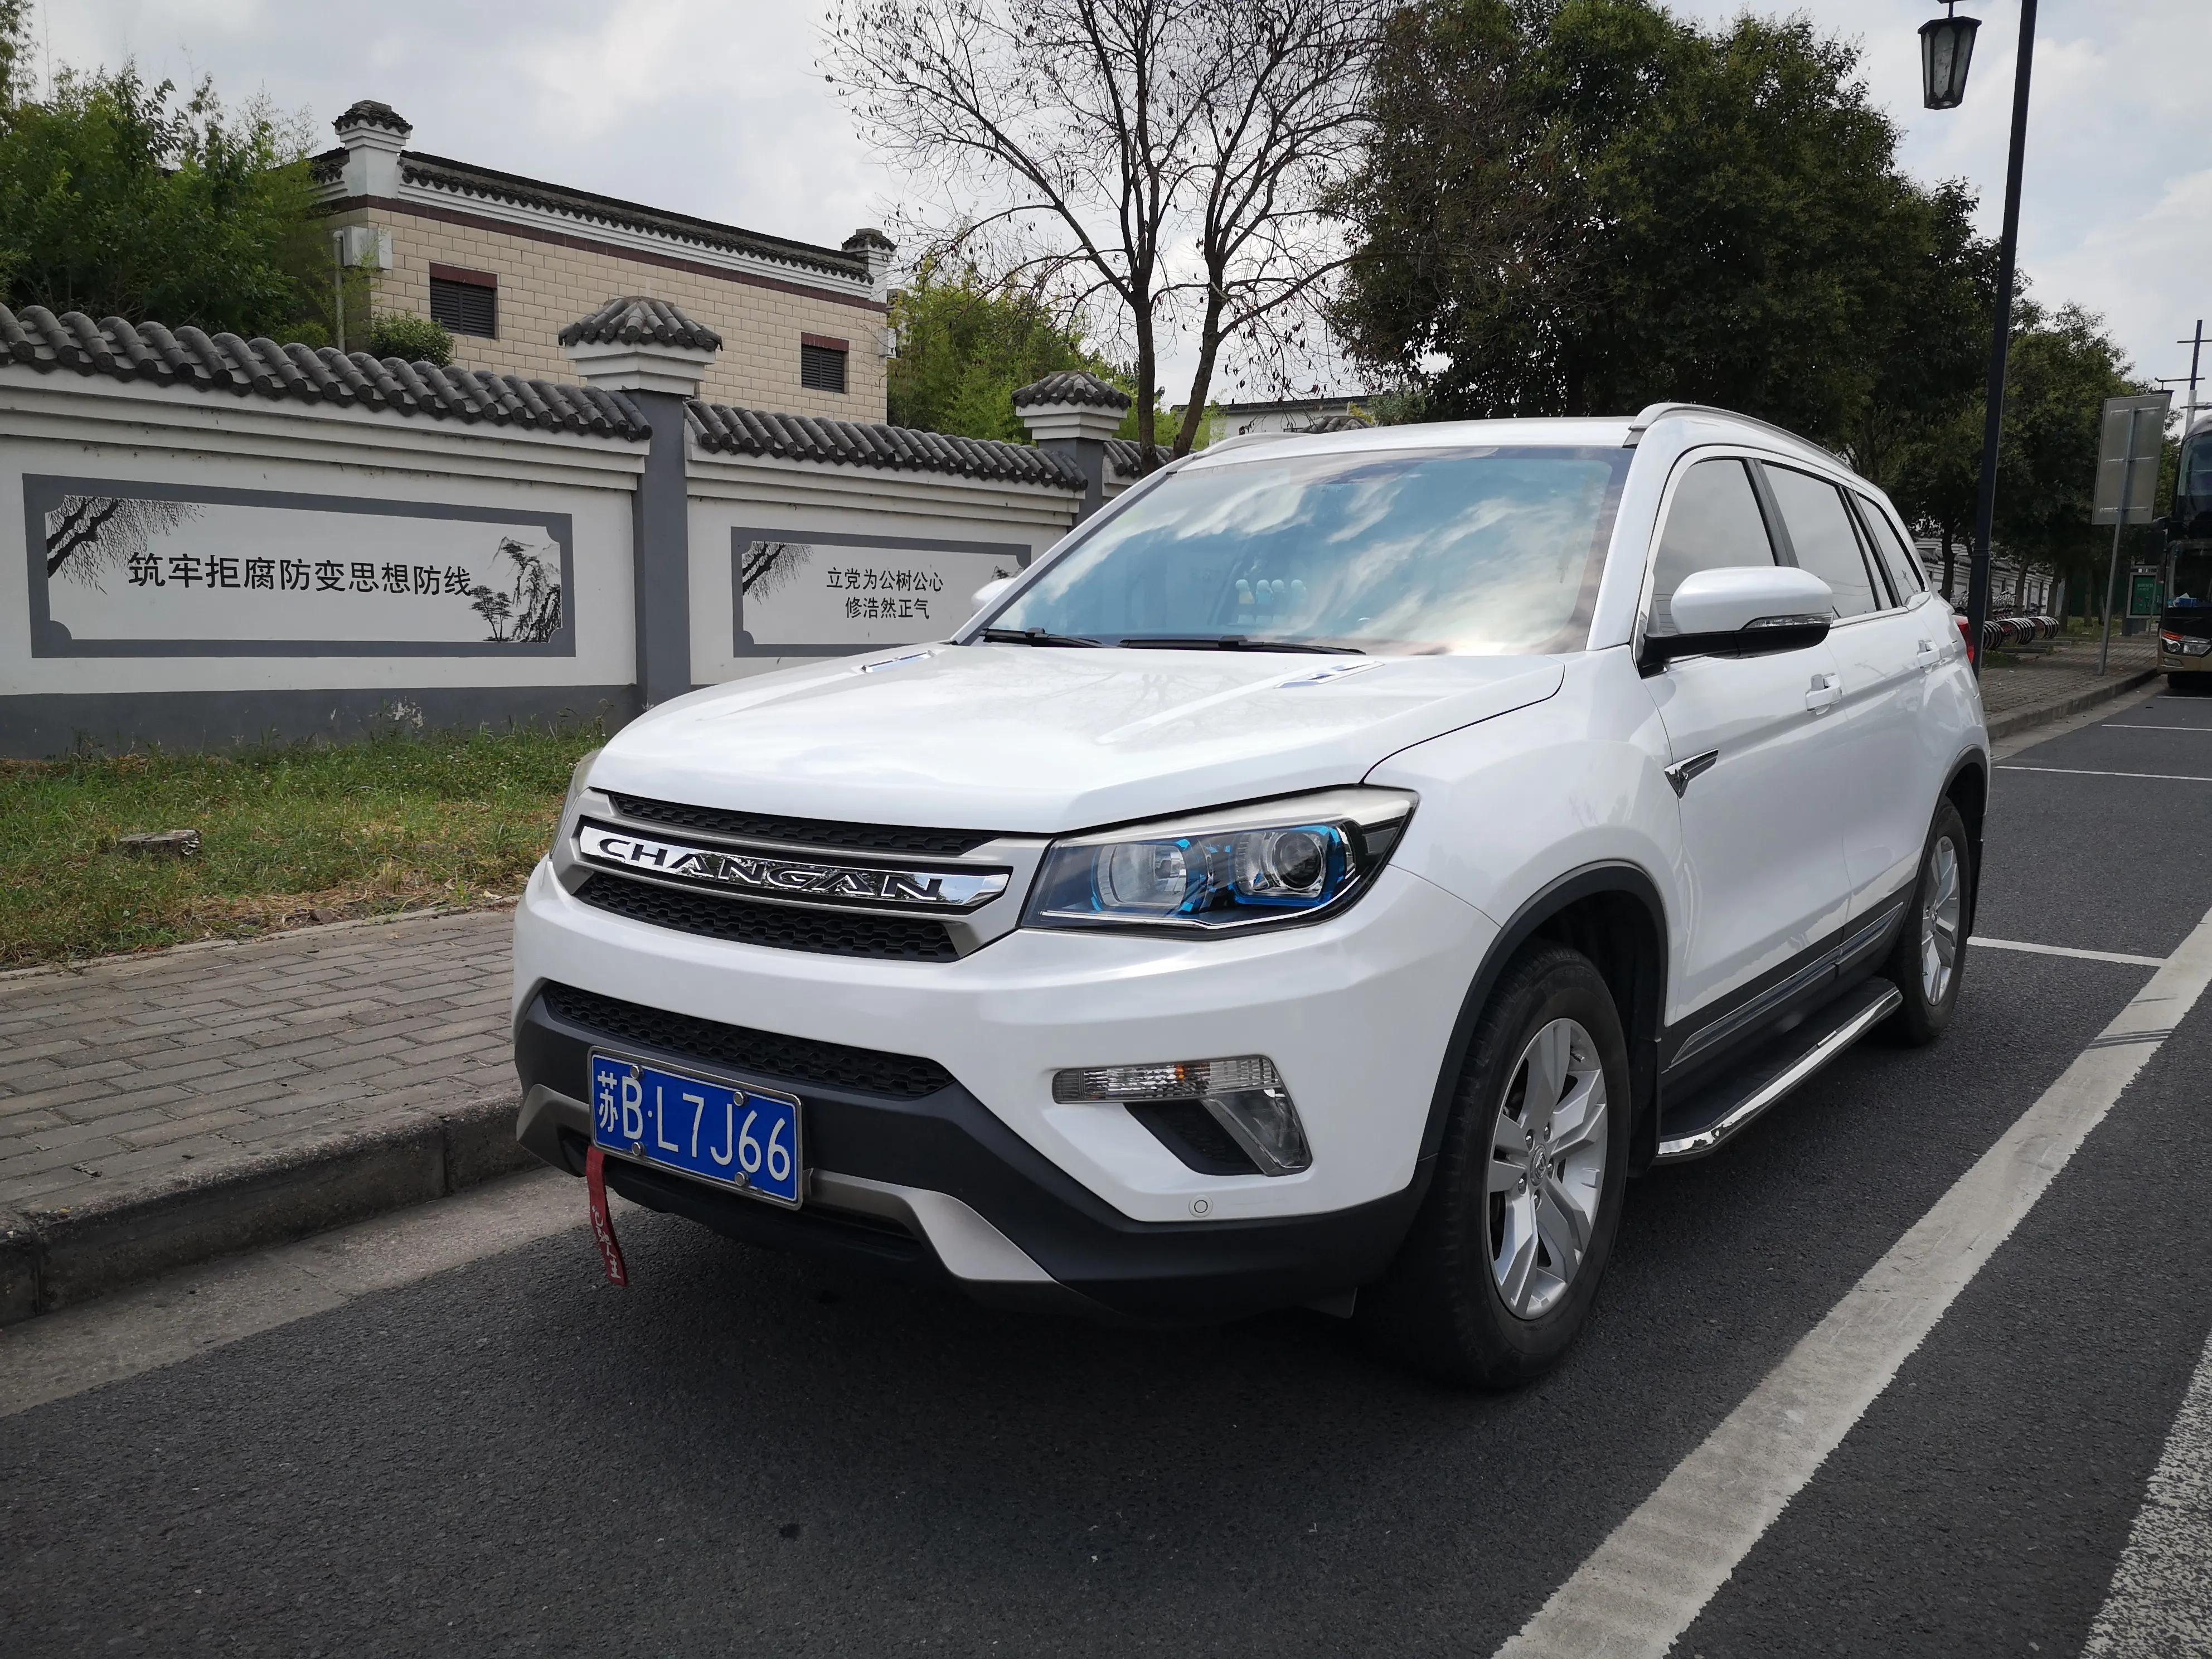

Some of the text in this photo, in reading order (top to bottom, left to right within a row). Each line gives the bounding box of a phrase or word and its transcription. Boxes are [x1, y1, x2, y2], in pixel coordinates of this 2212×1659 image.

[128, 552, 472, 597] 筑牢拒腐防变思想防线
[826, 566, 943, 592] 立党为公树公心
[845, 596, 929, 620] 修浩然正气
[598, 838, 943, 901] CHANGAN
